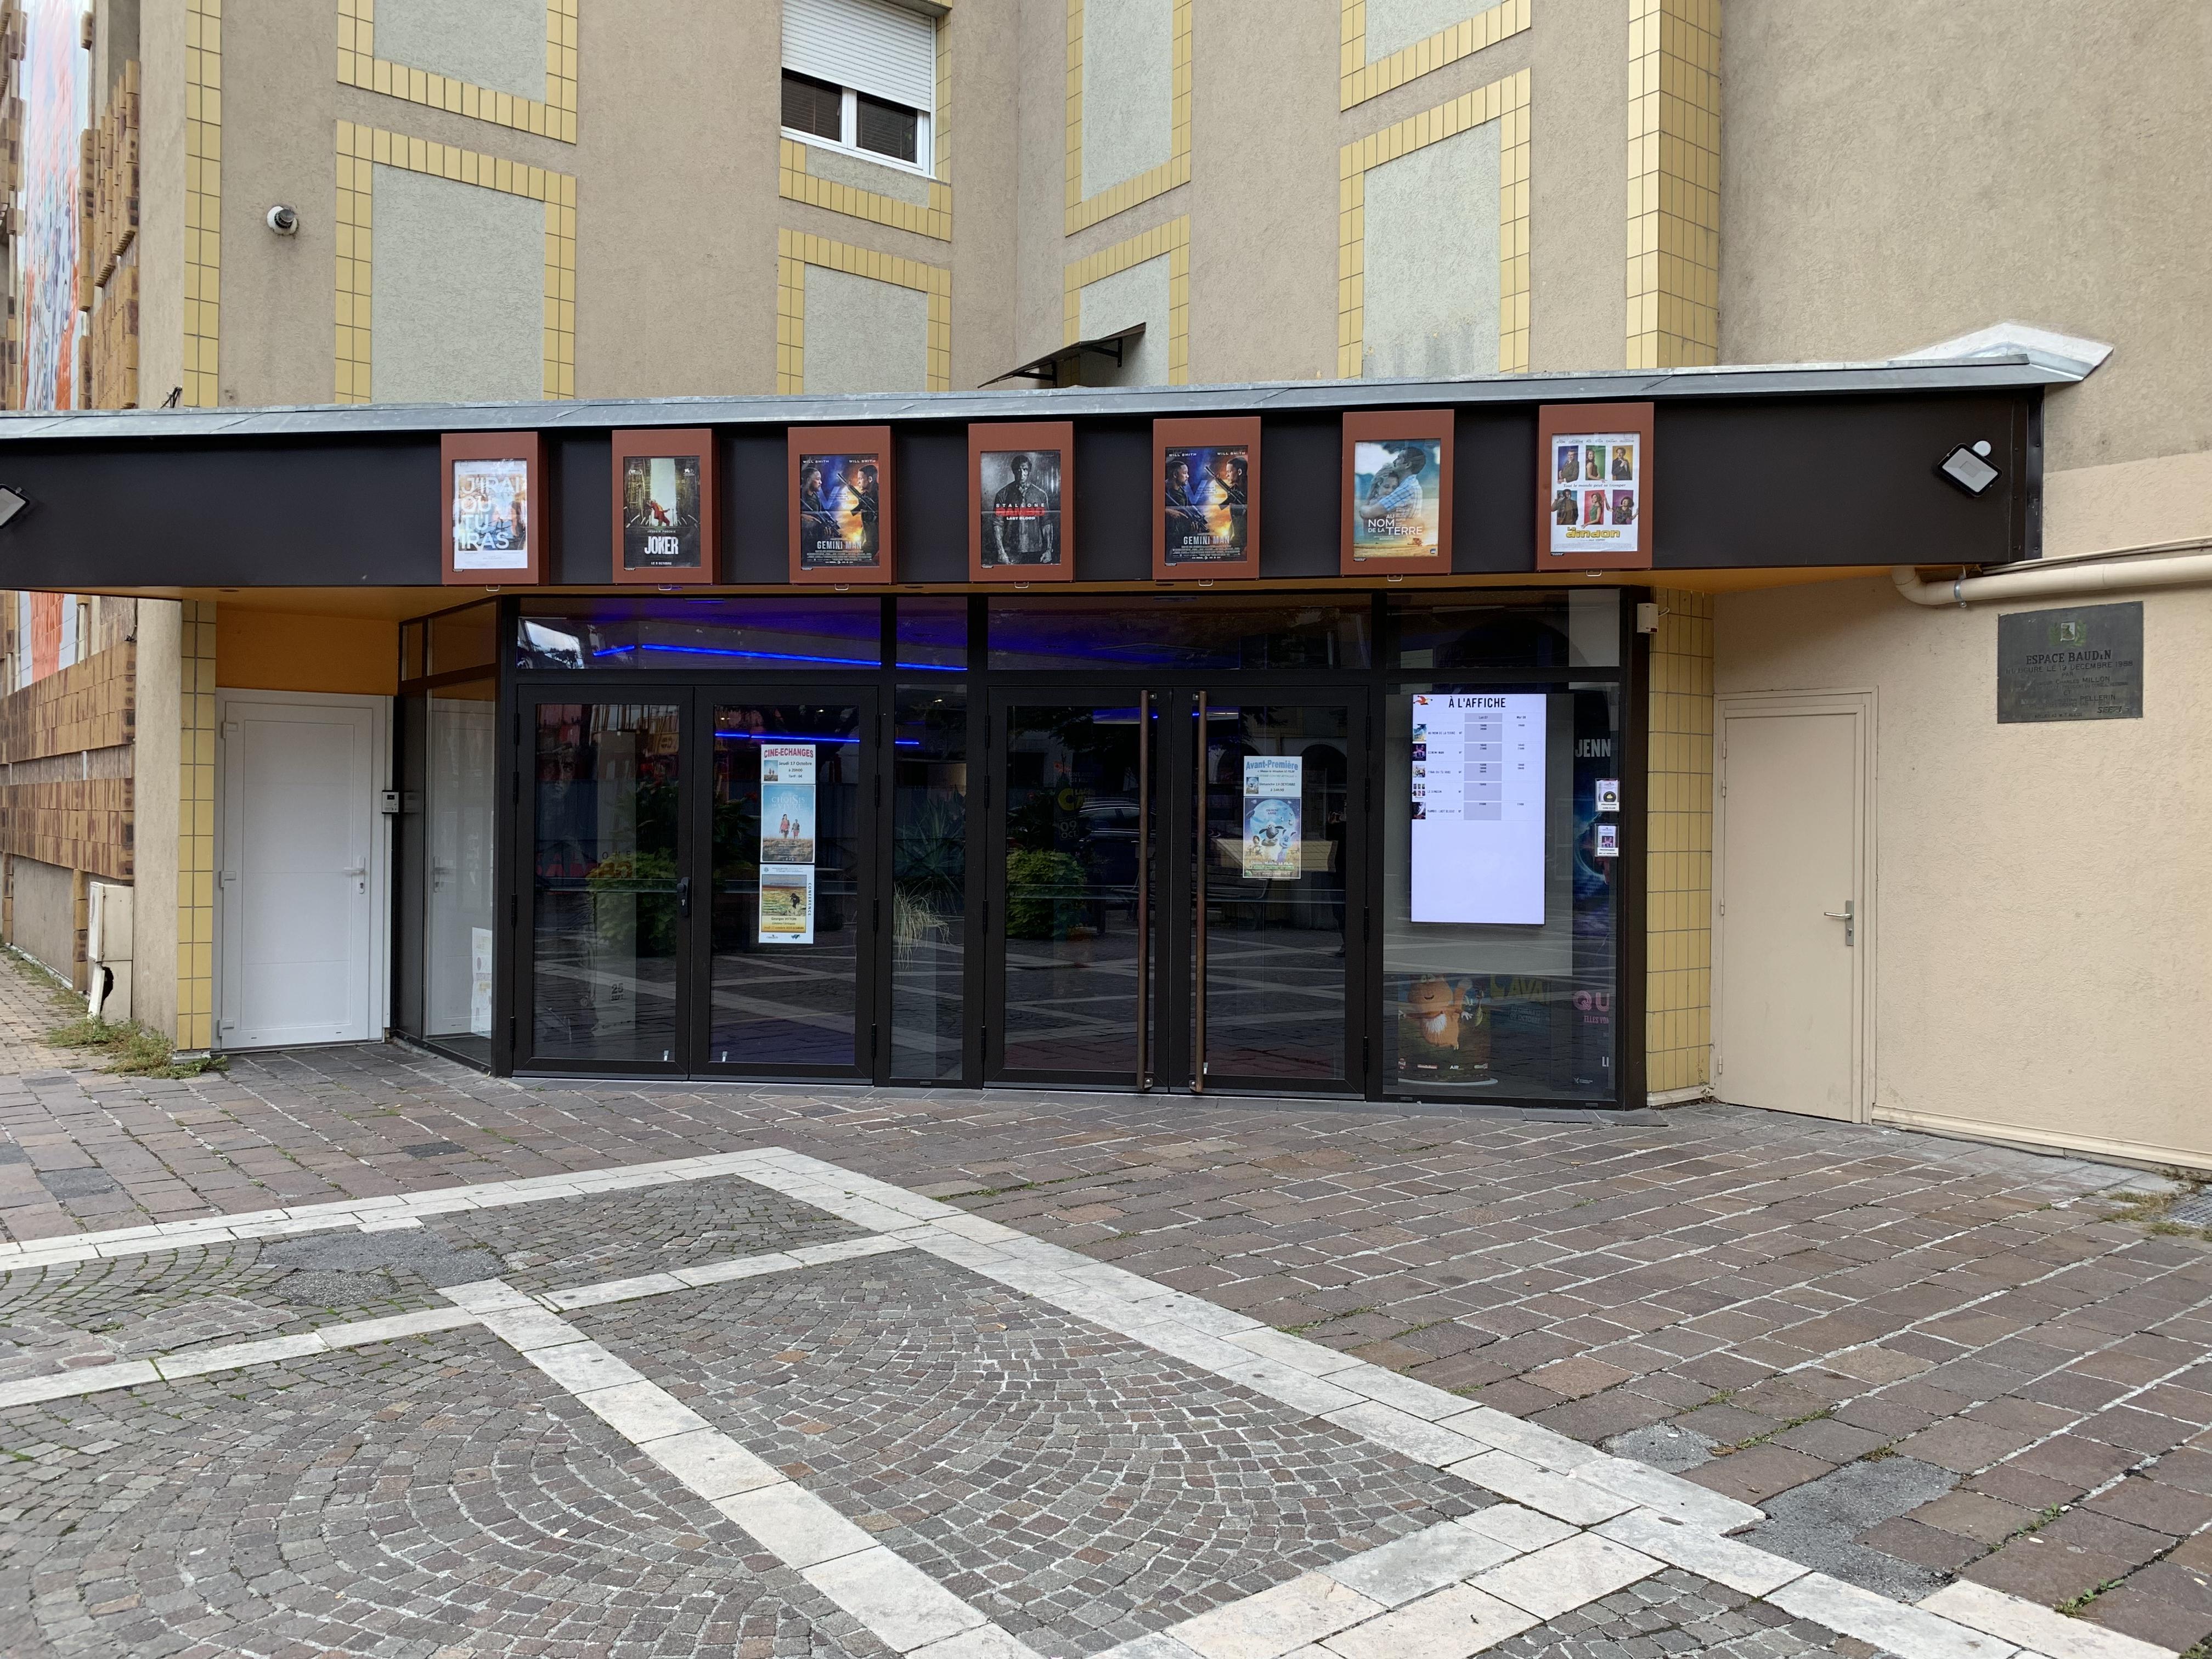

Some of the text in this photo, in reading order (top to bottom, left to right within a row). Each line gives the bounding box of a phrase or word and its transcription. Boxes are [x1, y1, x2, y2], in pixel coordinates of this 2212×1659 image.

[461, 476, 520, 494] J'IRAI
[462, 514, 489, 531] TU
[1368, 518, 1395, 527] NOM
[1386, 526, 1423, 535] TERRE
[461, 532, 509, 549] IRAS
[644, 535, 679, 555] JOKER
[817, 541, 862, 549] GEMINI MAN
[1183, 535, 1229, 545] GEMINI MAN
[2026, 653, 2064, 665] ESPACE
[1449, 696, 1506, 708] À L'AFFICHE
[764, 748, 814, 758] CINE-ECHANGES
[1246, 759, 1299, 770] Avant-Première
[1061, 820, 1076, 832] 09
[611, 983, 623, 995] 25
